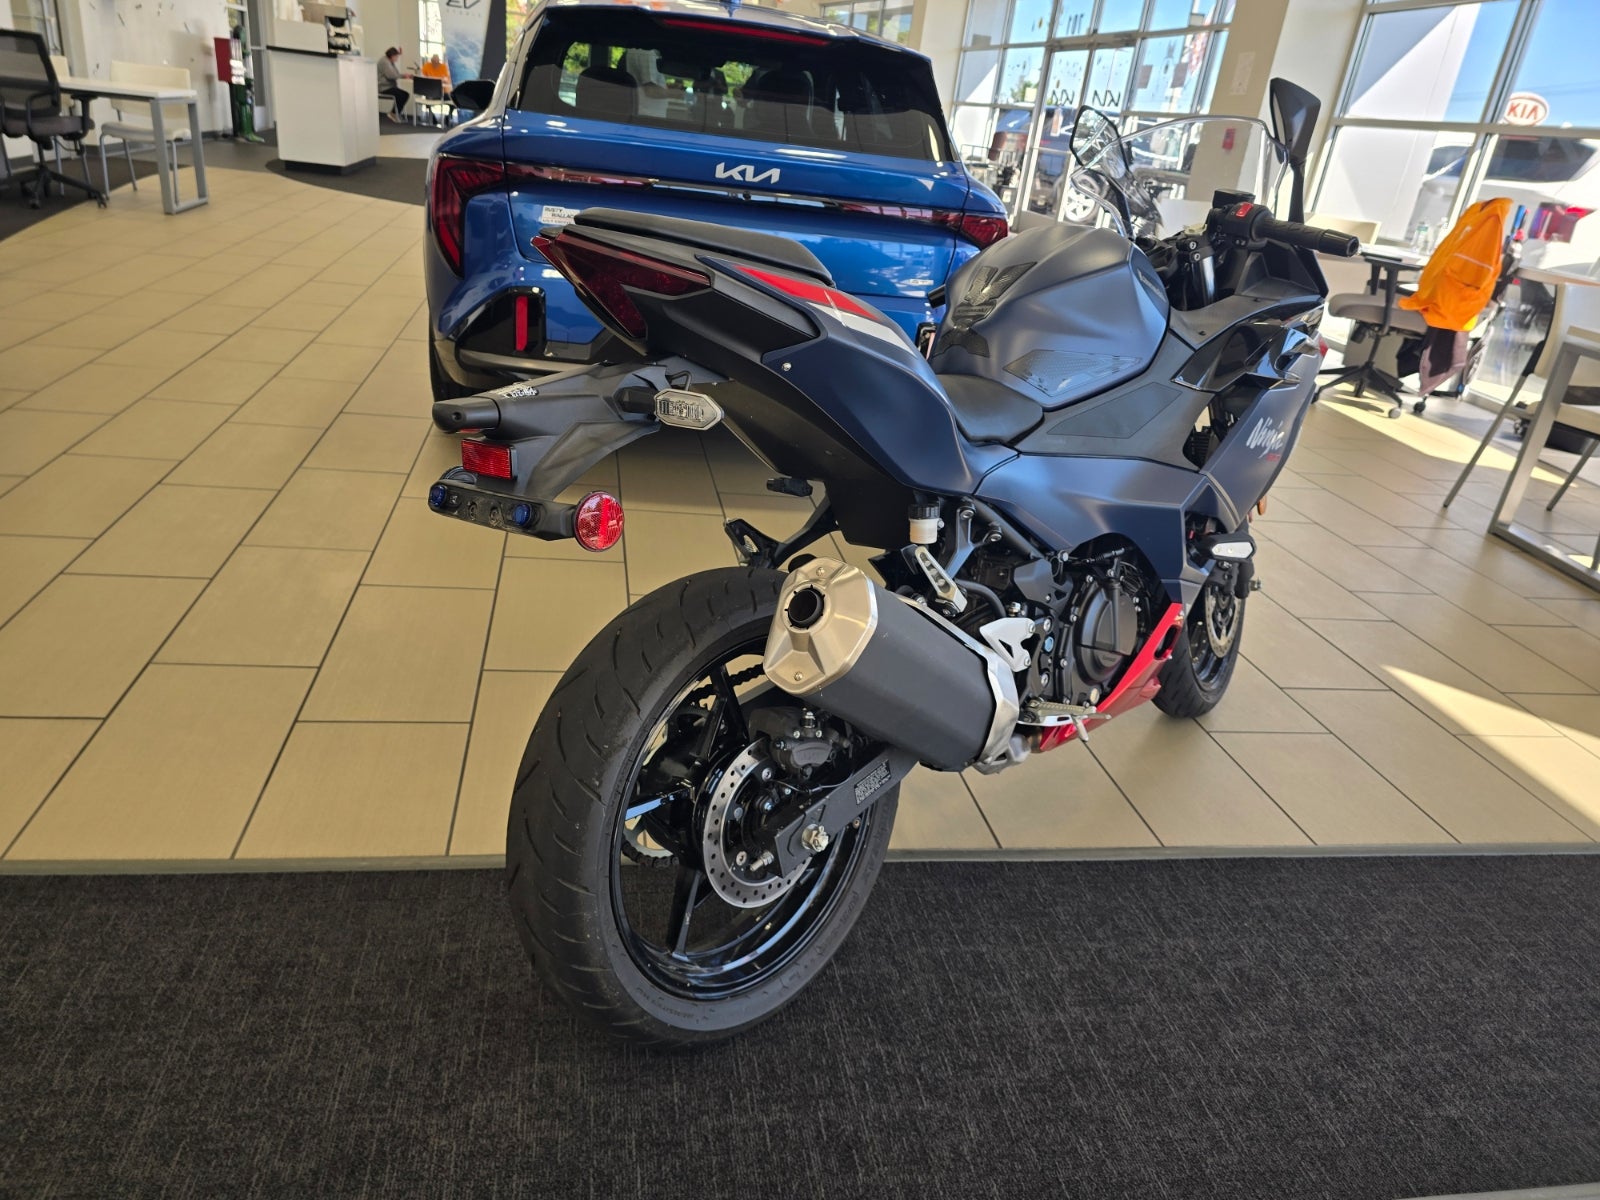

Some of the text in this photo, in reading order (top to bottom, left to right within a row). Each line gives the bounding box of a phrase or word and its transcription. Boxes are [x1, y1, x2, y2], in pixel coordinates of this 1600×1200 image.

[1507, 102, 1539, 120] KIA
[715, 162, 780, 184] KIA
[1246, 416, 1285, 459] Ninja
